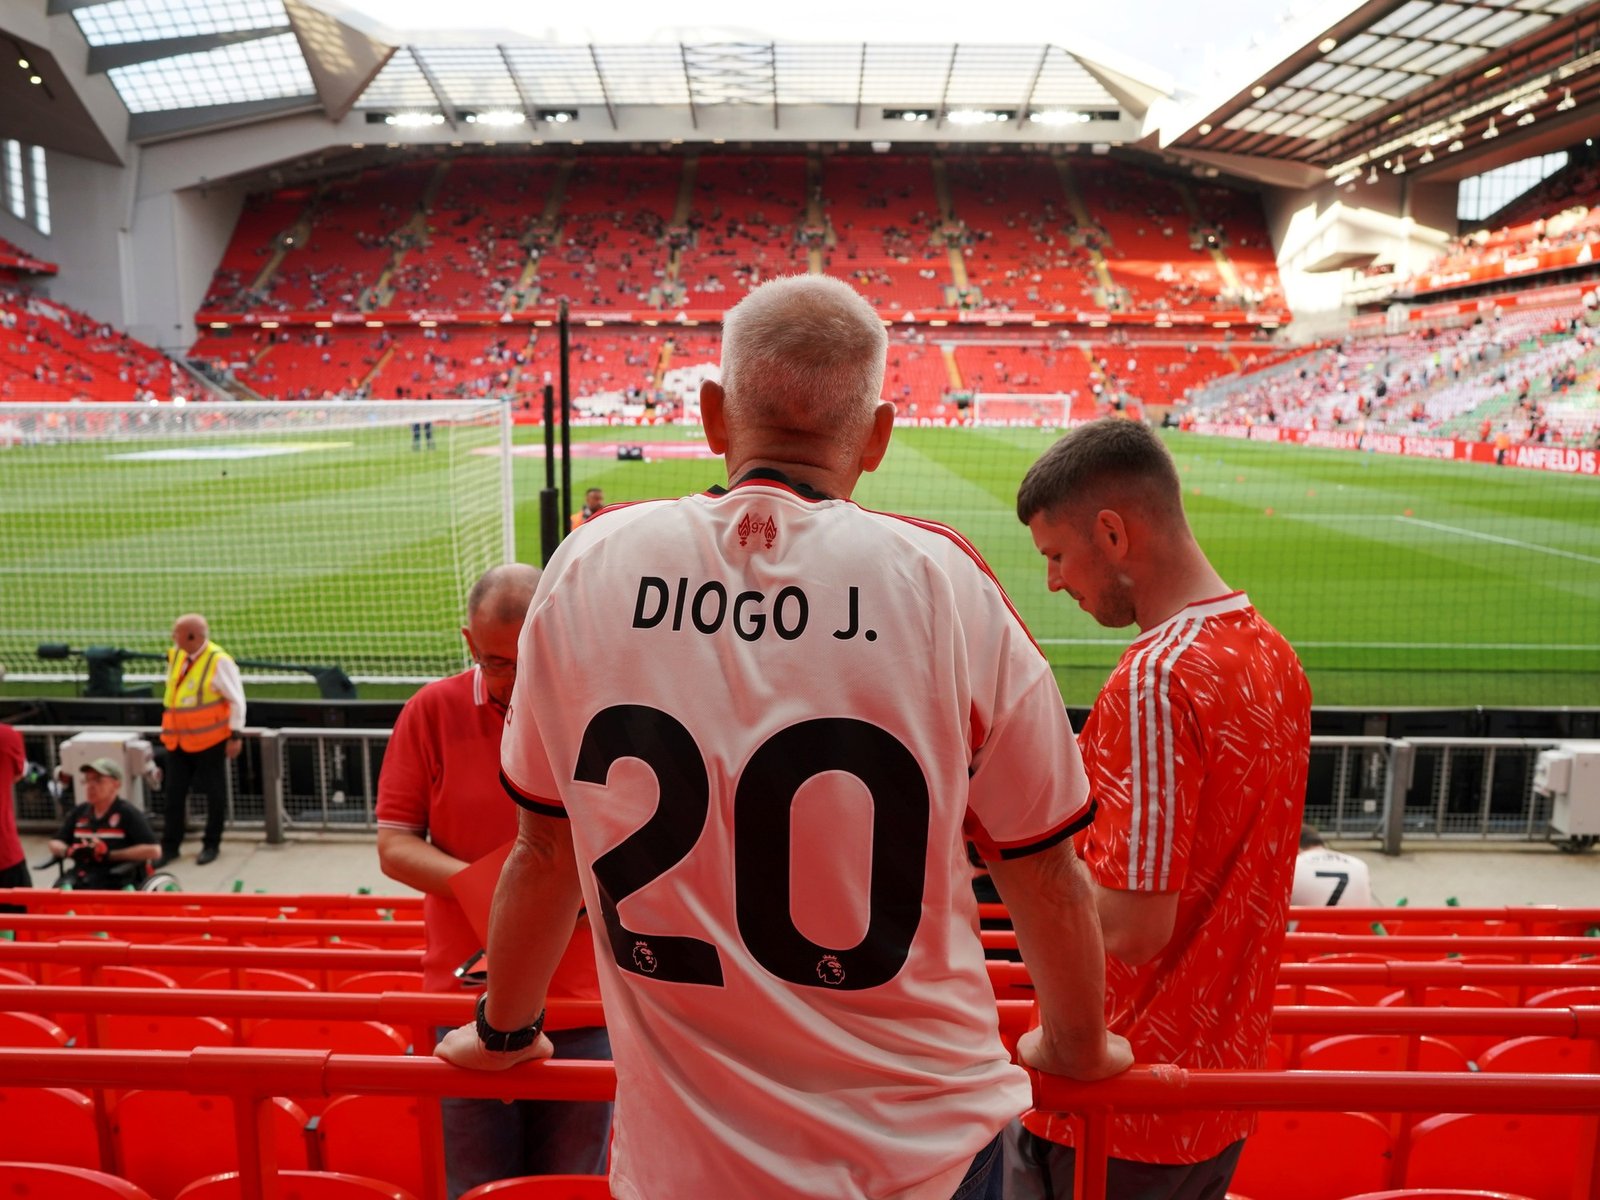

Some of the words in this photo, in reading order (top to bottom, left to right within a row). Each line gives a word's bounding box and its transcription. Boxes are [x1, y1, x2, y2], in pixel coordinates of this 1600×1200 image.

[1517, 445, 1580, 472] ANFIELD
[1581, 450, 1596, 474] IS
[751, 522, 765, 533] 97
[632, 576, 809, 641] DIOGO
[833, 586, 878, 641] J.
[573, 704, 930, 991] 20
[1315, 871, 1349, 906] 7
